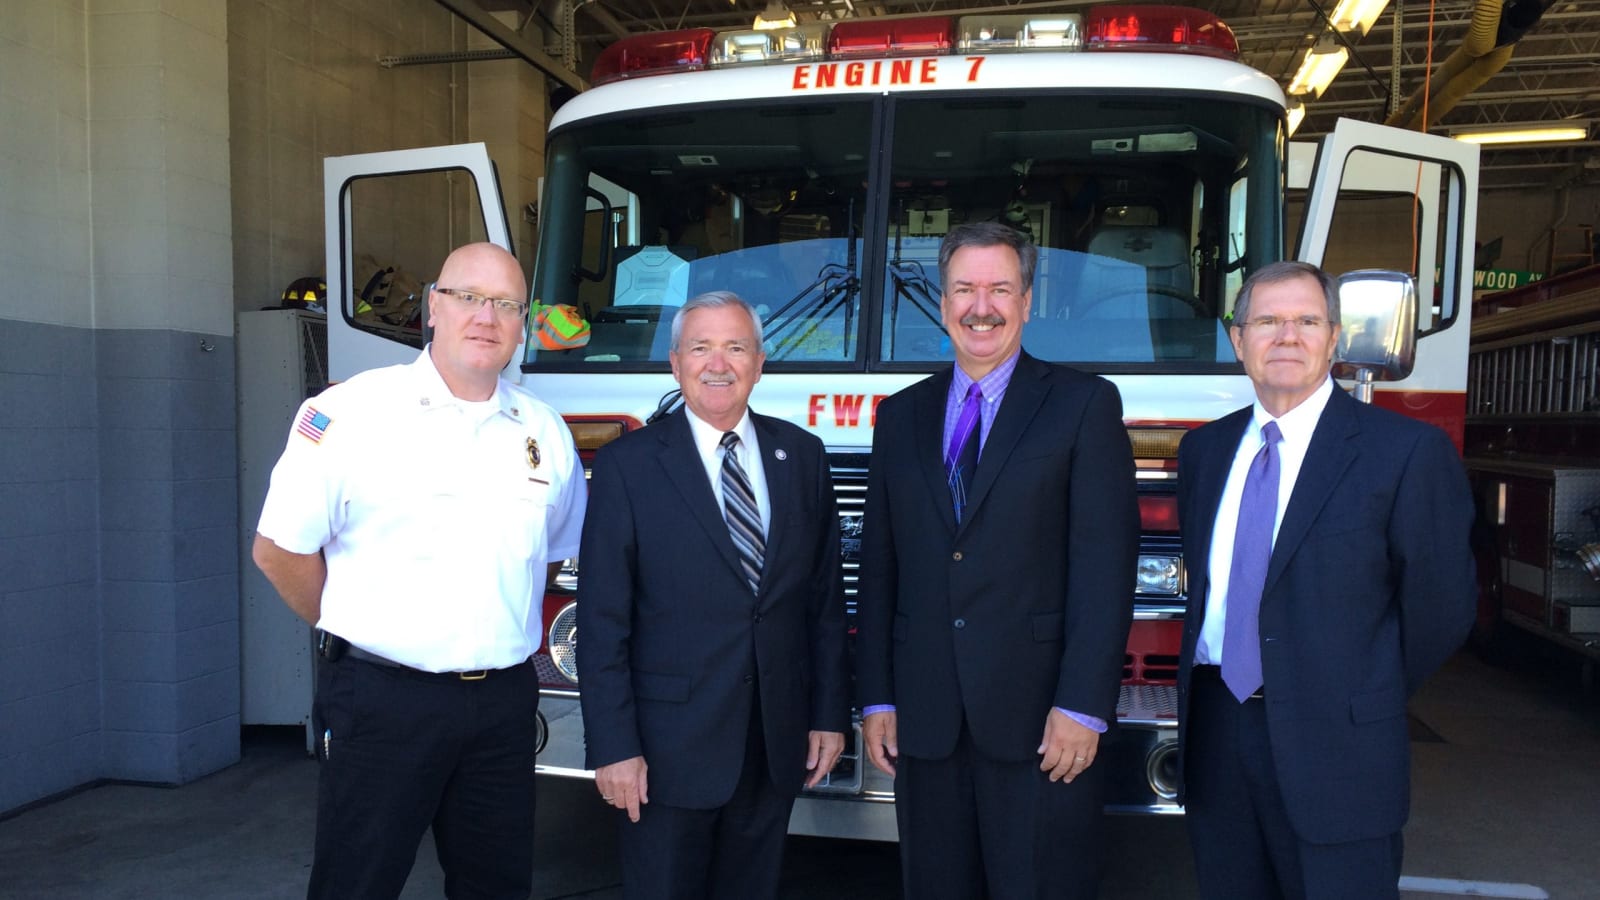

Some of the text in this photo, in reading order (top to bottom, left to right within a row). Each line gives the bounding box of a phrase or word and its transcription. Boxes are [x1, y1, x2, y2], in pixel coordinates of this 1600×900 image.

[793, 56, 986, 90] ENGINE 7
[1529, 273, 1543, 282] AV
